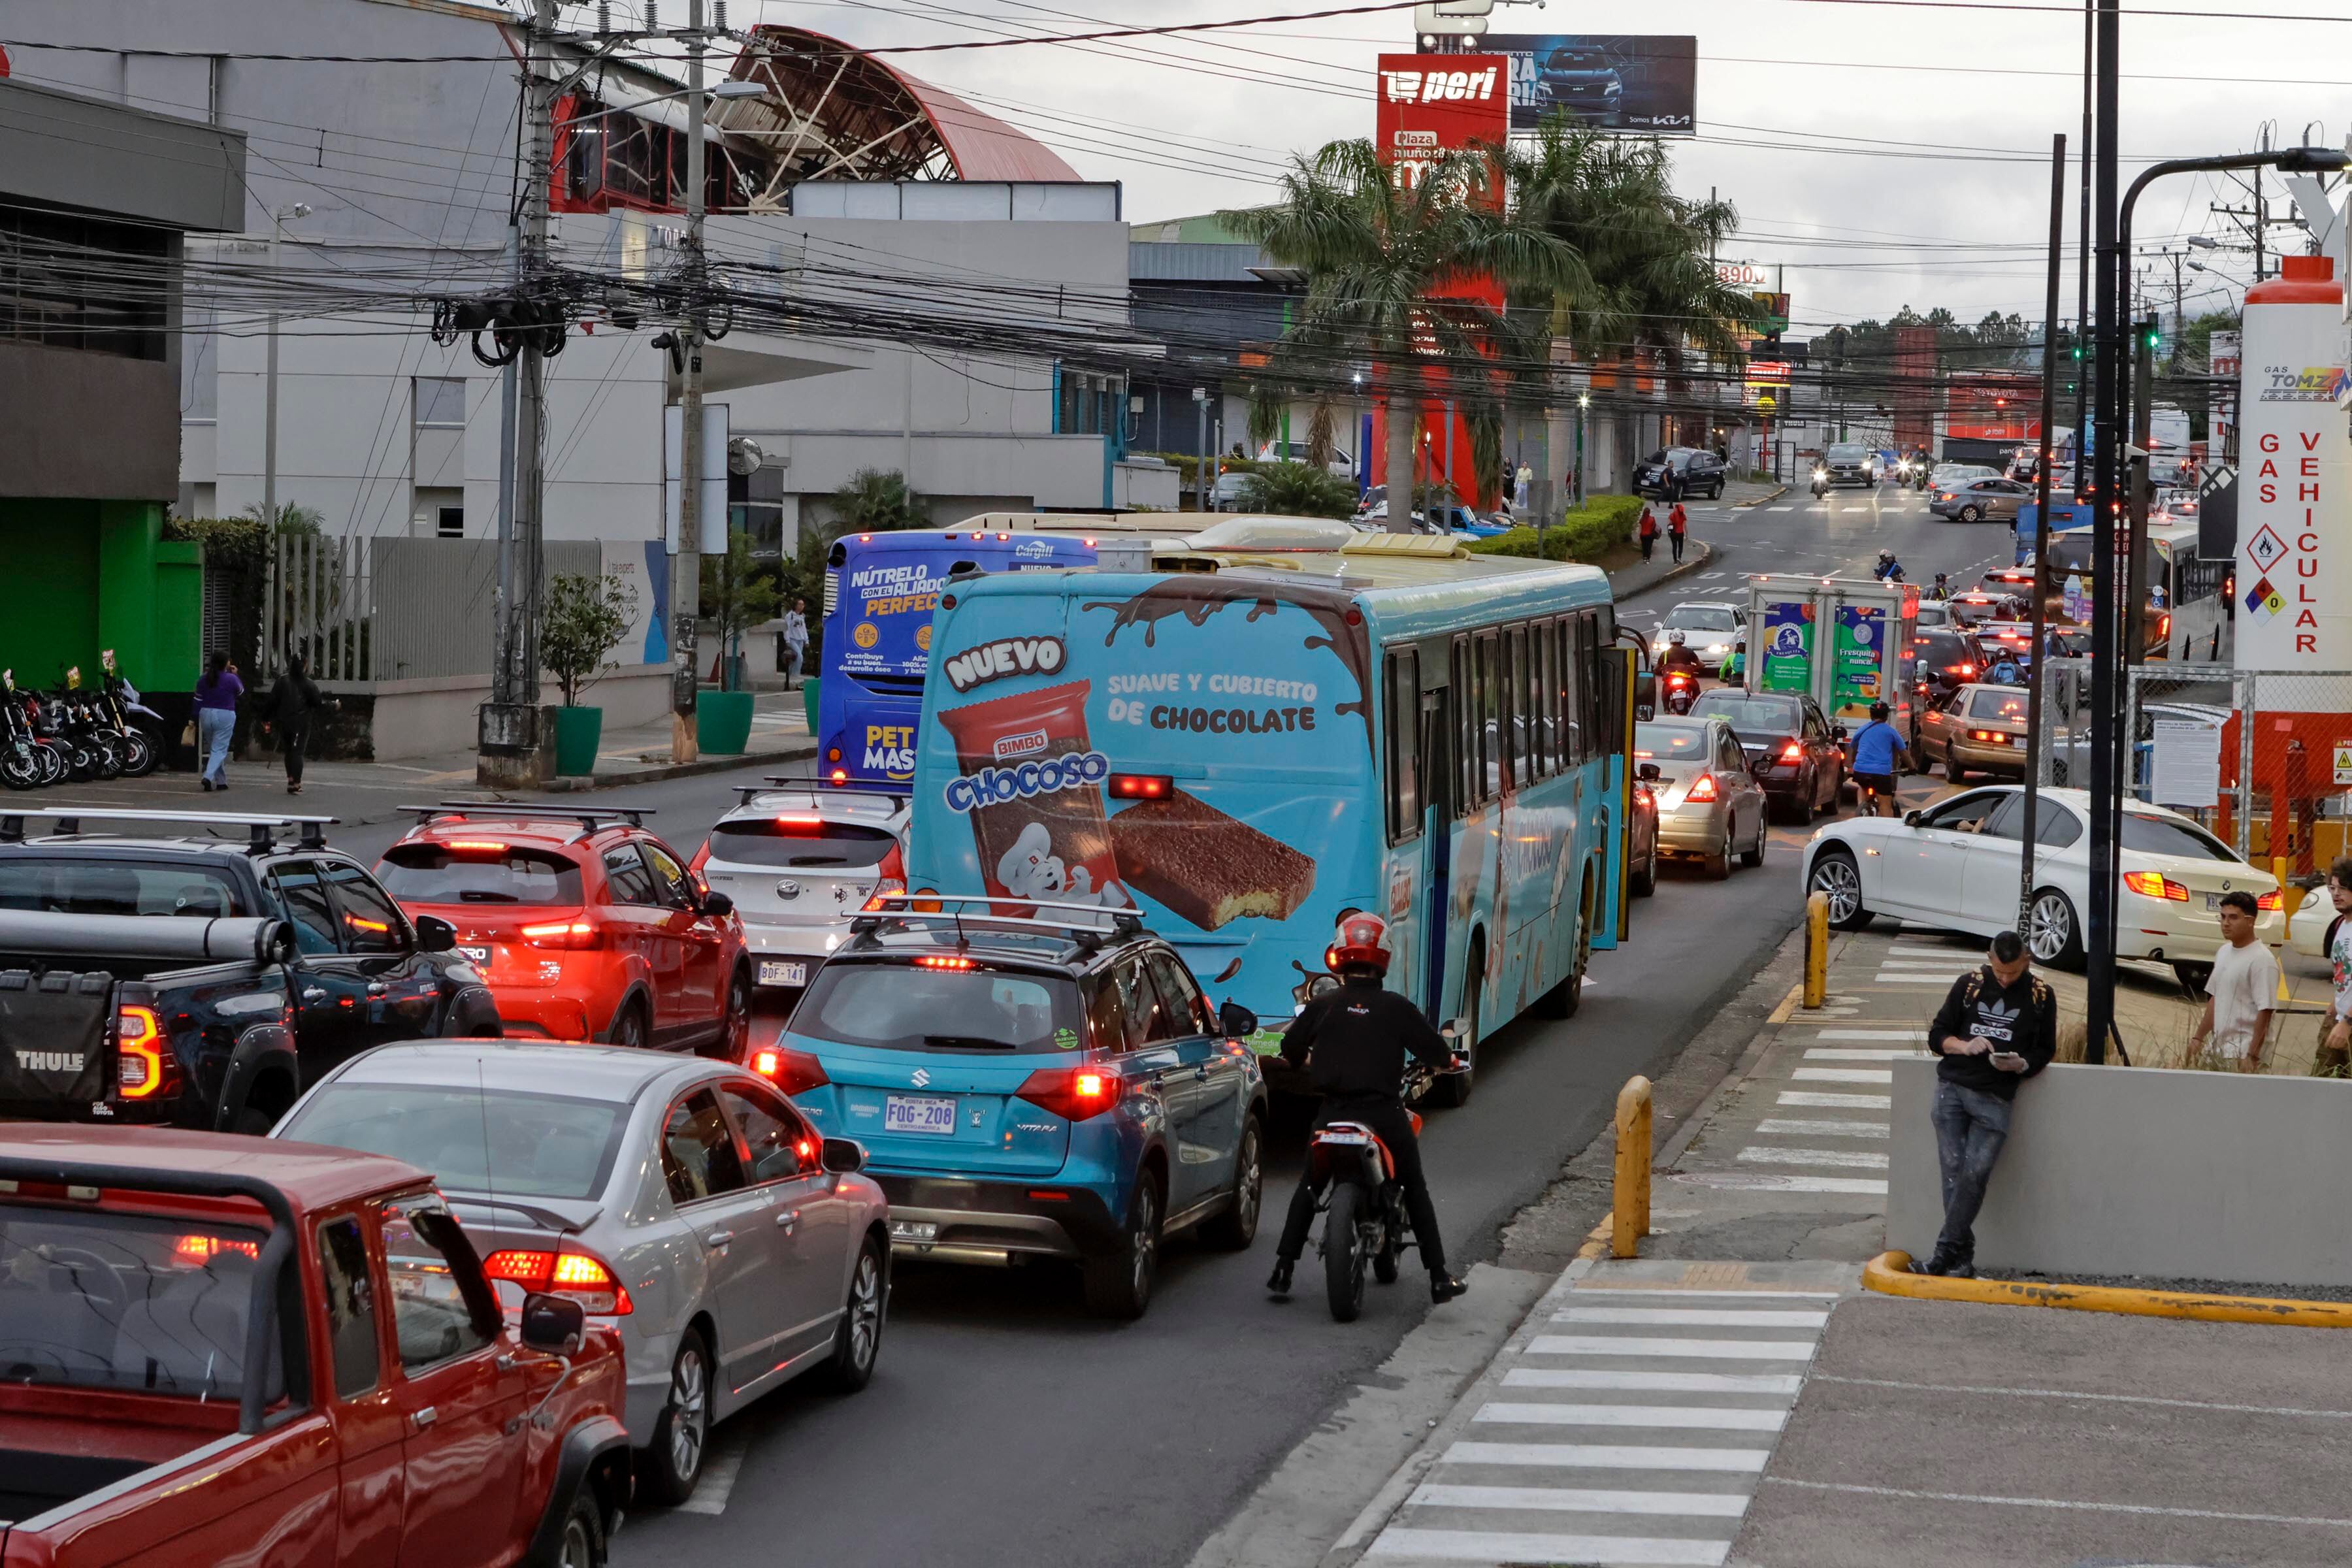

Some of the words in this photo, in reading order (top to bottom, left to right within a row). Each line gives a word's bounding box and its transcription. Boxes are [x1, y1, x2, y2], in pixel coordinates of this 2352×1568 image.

[1422, 67, 1497, 103] peri
[1653, 115, 1690, 125] KIA
[1398, 133, 1433, 144] Plaza
[2259, 434, 2279, 503] GAS
[1015, 544, 1054, 559] Cargill
[2295, 432, 2321, 653] VEHICULAR
[851, 564, 928, 587] NÚTRELO
[862, 589, 879, 597] CON
[893, 578, 947, 596] ALIADO
[866, 593, 938, 617] PERFEC
[2270, 597, 2278, 608] 0
[948, 640, 1061, 688] NUEVO
[1839, 649, 1875, 657] Fresquita
[1108, 674, 1180, 694] SUAVE
[1187, 674, 1201, 691] Y
[1209, 674, 1318, 702] CUBIERTO
[1108, 698, 1145, 725] DE
[1151, 705, 1316, 734] CHOCOLATE
[867, 725, 914, 748] PET
[997, 734, 1045, 755] BIMBO
[862, 747, 917, 770] MAS
[947, 754, 1107, 811] CHOCOSO
[762, 968, 804, 981] BDF-141
[1972, 1026, 2008, 1039] adidas
[16, 1051, 84, 1071] THULE
[888, 1103, 953, 1126] FQG-208
[1017, 1124, 1057, 1132] VITARA
